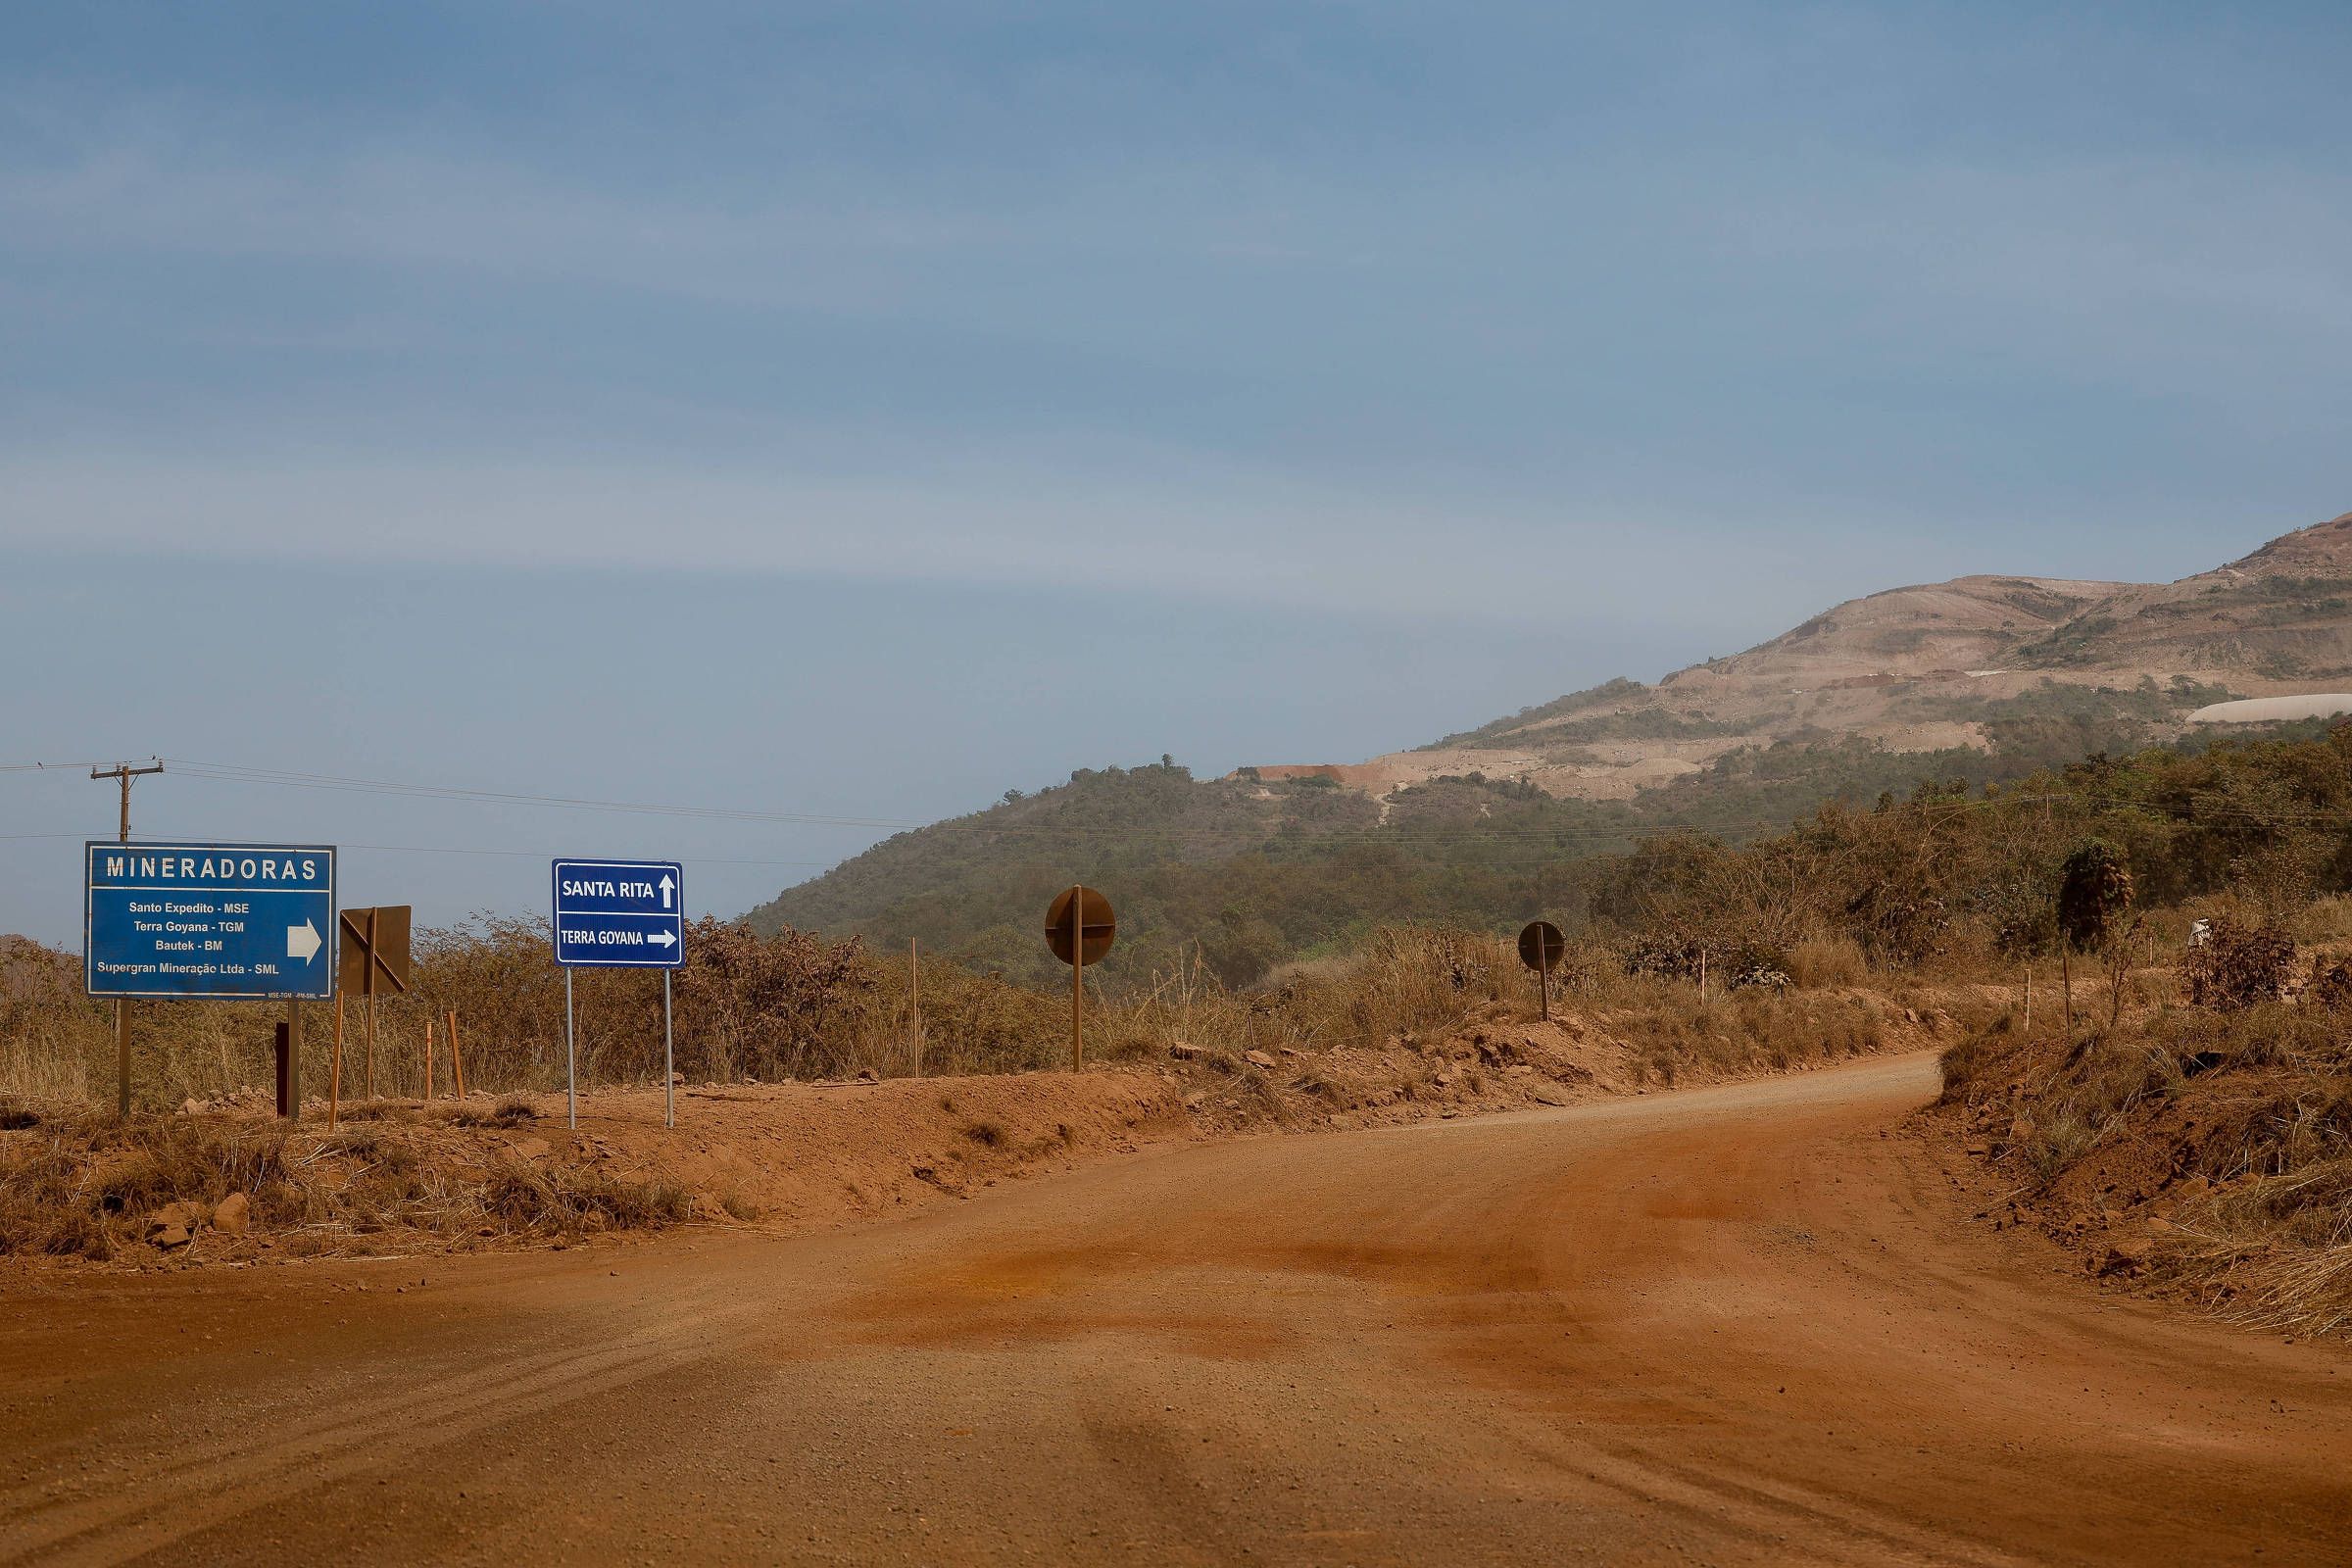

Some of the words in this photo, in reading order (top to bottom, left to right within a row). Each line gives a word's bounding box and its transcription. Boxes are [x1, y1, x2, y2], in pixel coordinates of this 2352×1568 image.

[107, 857, 316, 880] MINERADORAS
[563, 880, 616, 898] SANTA
[619, 882, 655, 899] RITA
[128, 902, 162, 913] Santo
[165, 902, 215, 915] Expedito
[223, 903, 250, 913] MSE
[133, 920, 163, 932] Terra
[166, 920, 209, 934] Goyana
[218, 921, 244, 933] TGM
[155, 940, 195, 951] Bautek
[204, 940, 222, 951] BM
[561, 930, 597, 945] TERRA
[598, 930, 644, 946] GOYANA
[97, 961, 156, 975] Supergran
[159, 962, 217, 976] Mineração
[220, 963, 245, 974] Ltda
[254, 963, 279, 975] SML
